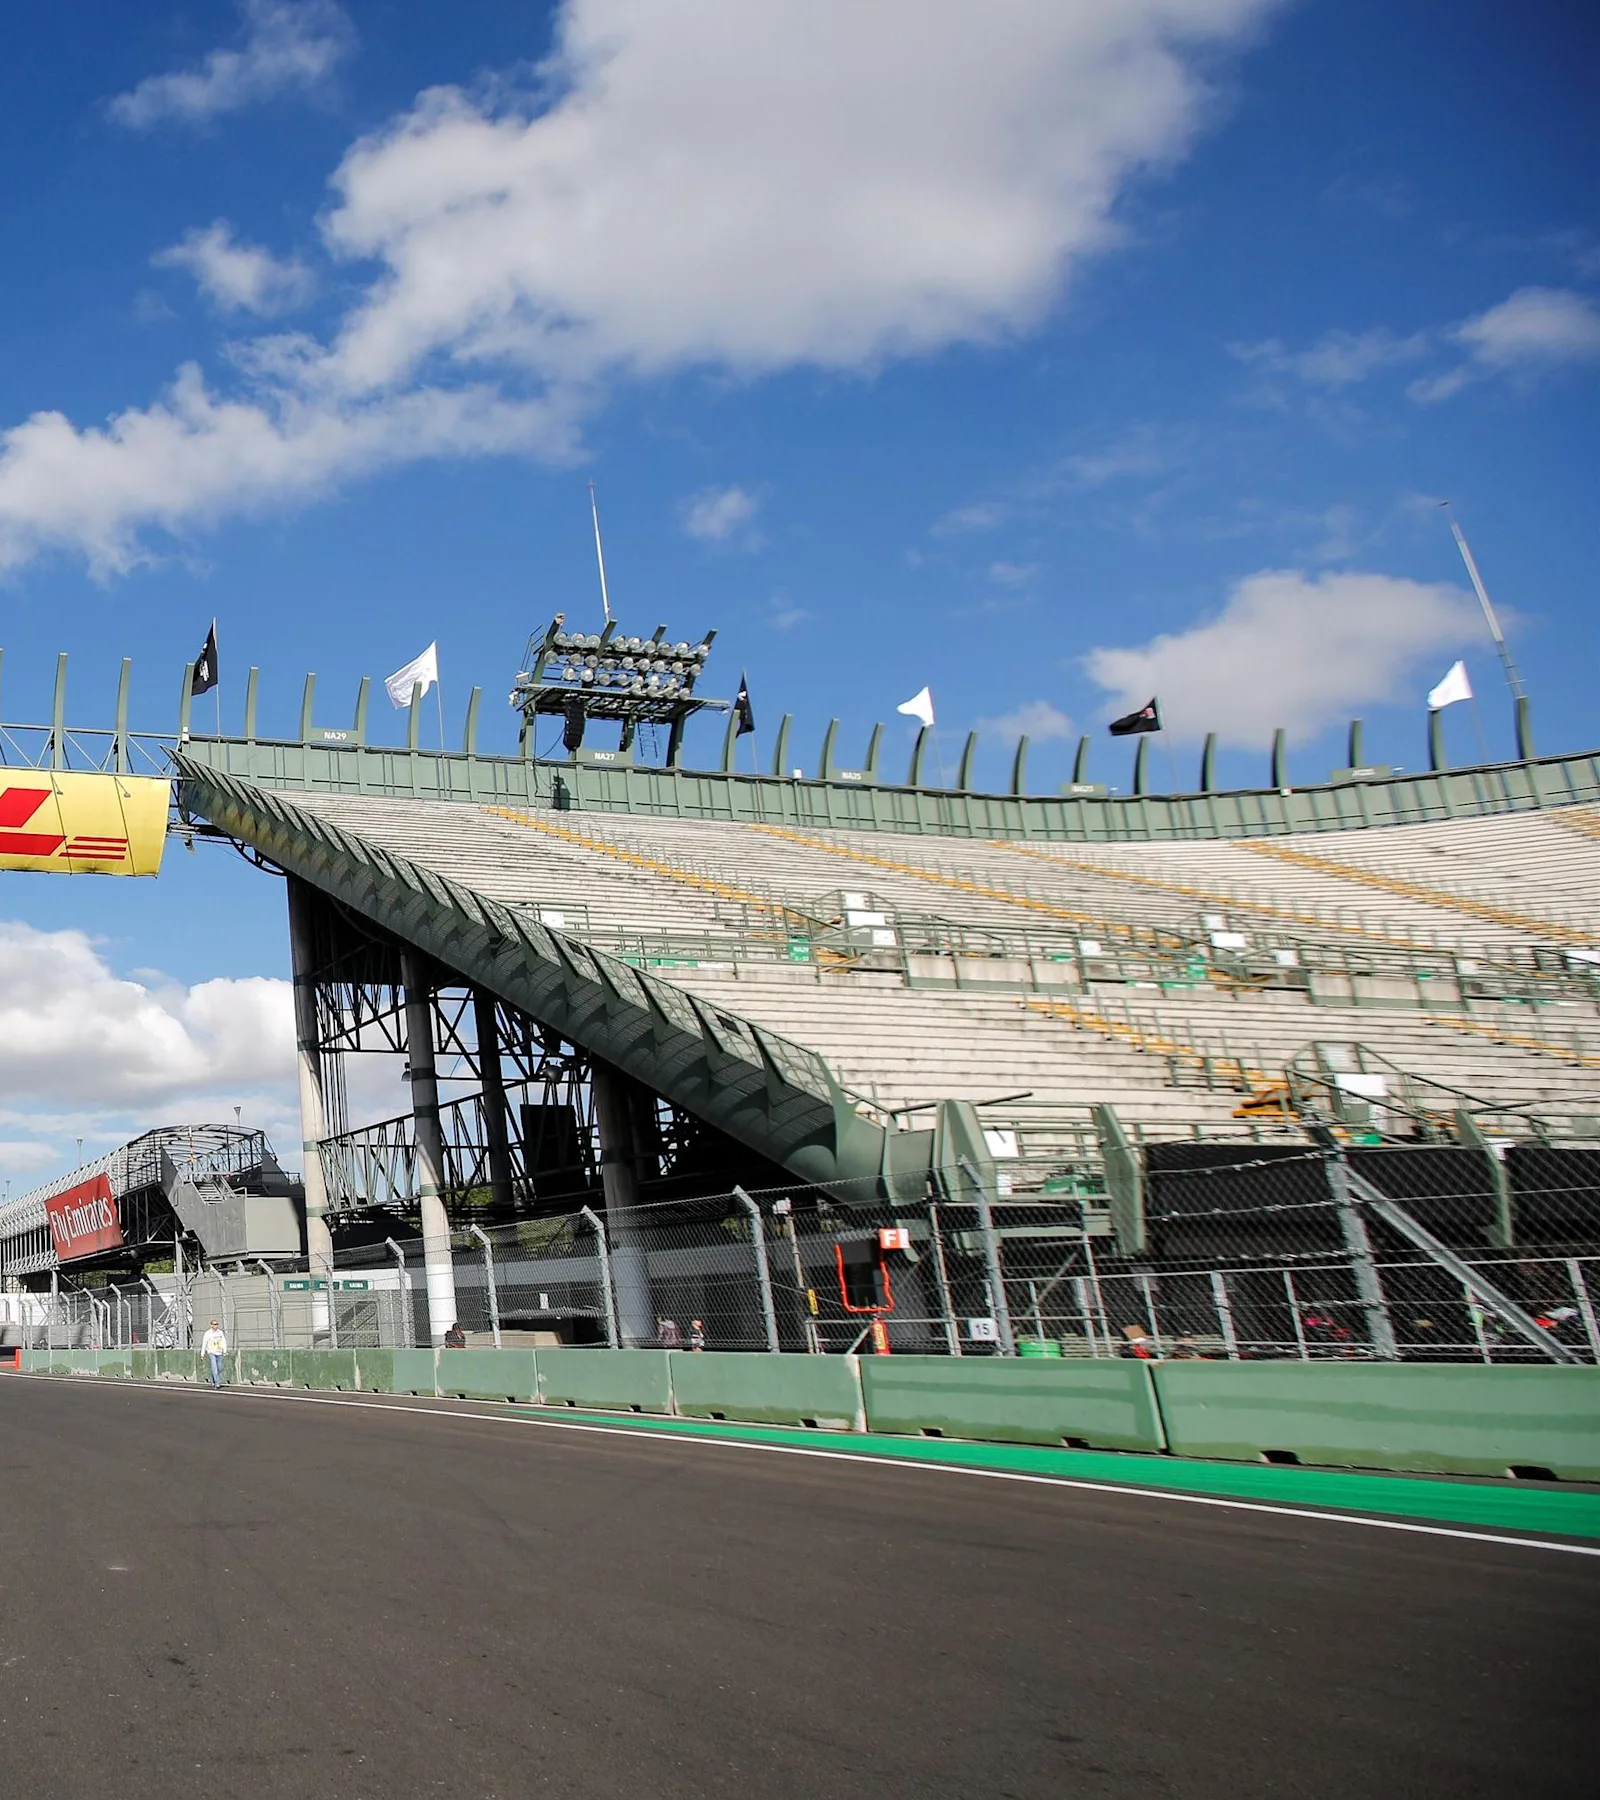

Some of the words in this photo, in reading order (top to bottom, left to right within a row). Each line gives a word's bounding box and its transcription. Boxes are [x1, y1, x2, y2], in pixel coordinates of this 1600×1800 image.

[324, 731, 347, 740] NA29
[594, 752, 615, 760] NA27
[50, 1209, 71, 1248] Fly
[64, 1196, 113, 1239] Emirates
[884, 1230, 897, 1246] F
[975, 1323, 989, 1335] 15
